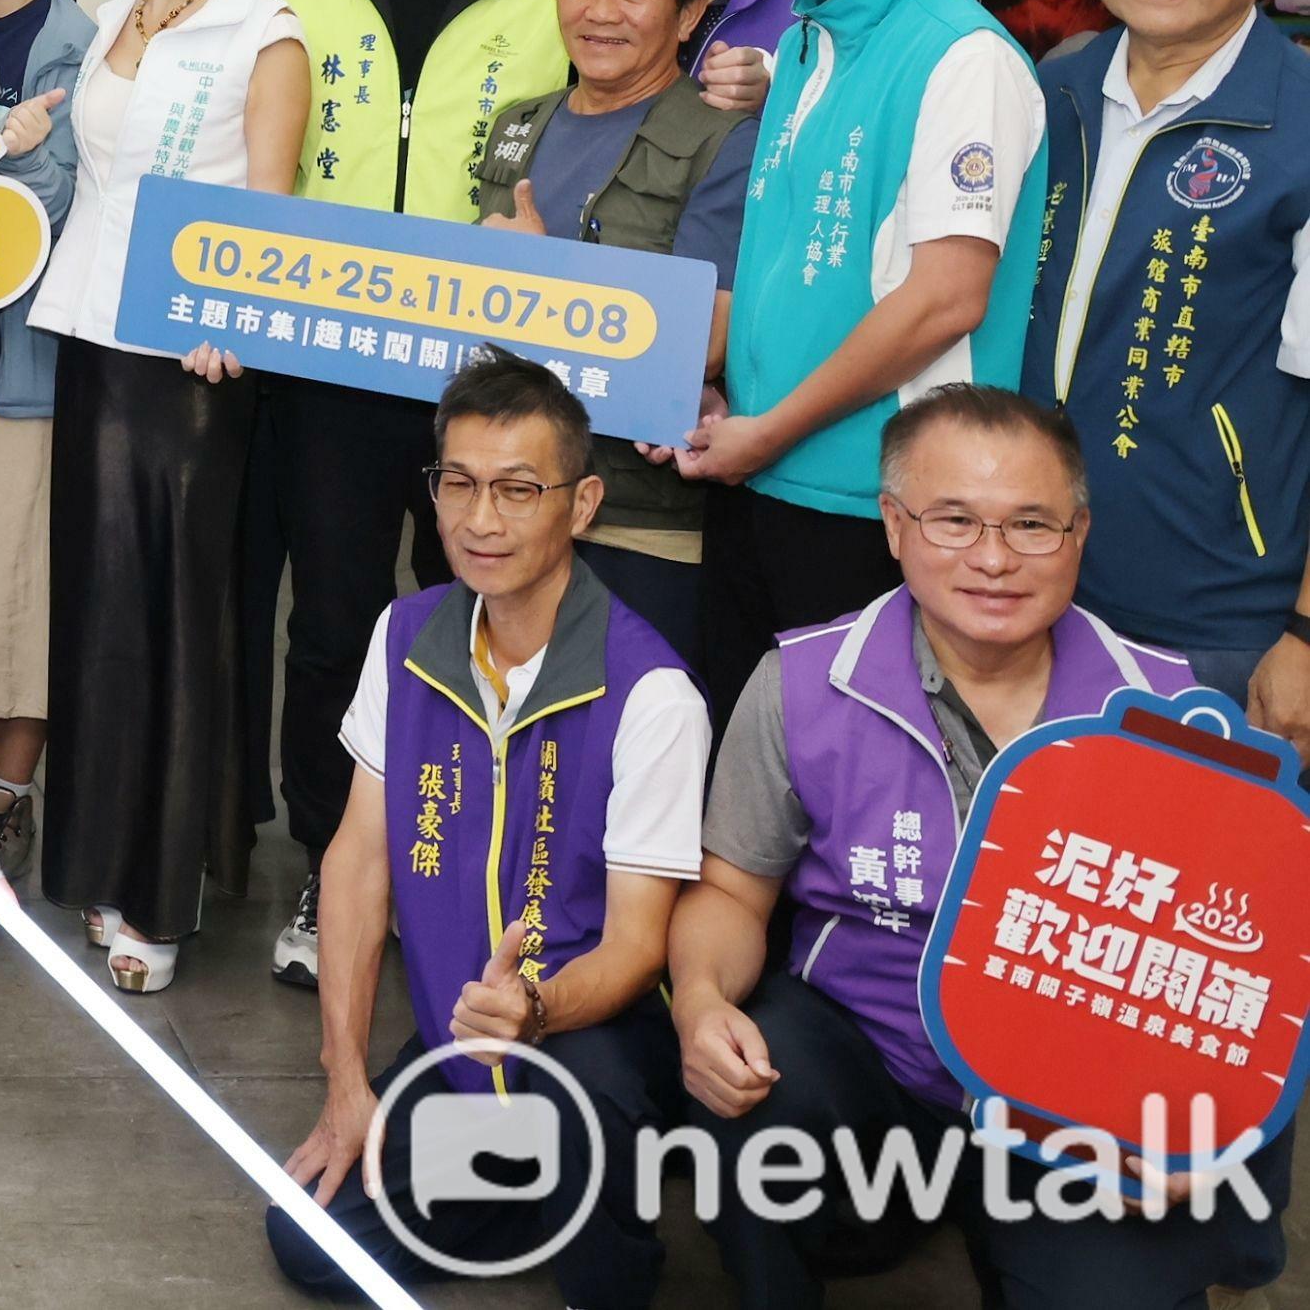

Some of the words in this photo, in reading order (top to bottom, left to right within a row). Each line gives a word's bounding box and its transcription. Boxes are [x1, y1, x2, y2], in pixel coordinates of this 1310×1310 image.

[316, 53, 346, 180] 林憲堂
[354, 33, 377, 105] 理事長
[801, 169, 836, 287] 經理人協會
[825, 125, 865, 268] 台南市旅行業
[197, 235, 312, 289] 10.24
[564, 298, 627, 344] 08
[1111, 228, 1174, 459] 旅館商業同業公會
[1163, 214, 1215, 389] 臺南市直轄市
[408, 762, 448, 879] 張豪傑
[892, 809, 925, 907] 總幹事
[1034, 828, 1181, 924] 泥好
[1186, 902, 1254, 943] 2026
[982, 953, 1251, 1067] 臺南關子嶺溫泉美食節
[994, 887, 1272, 1040] 歡迎關嶺
